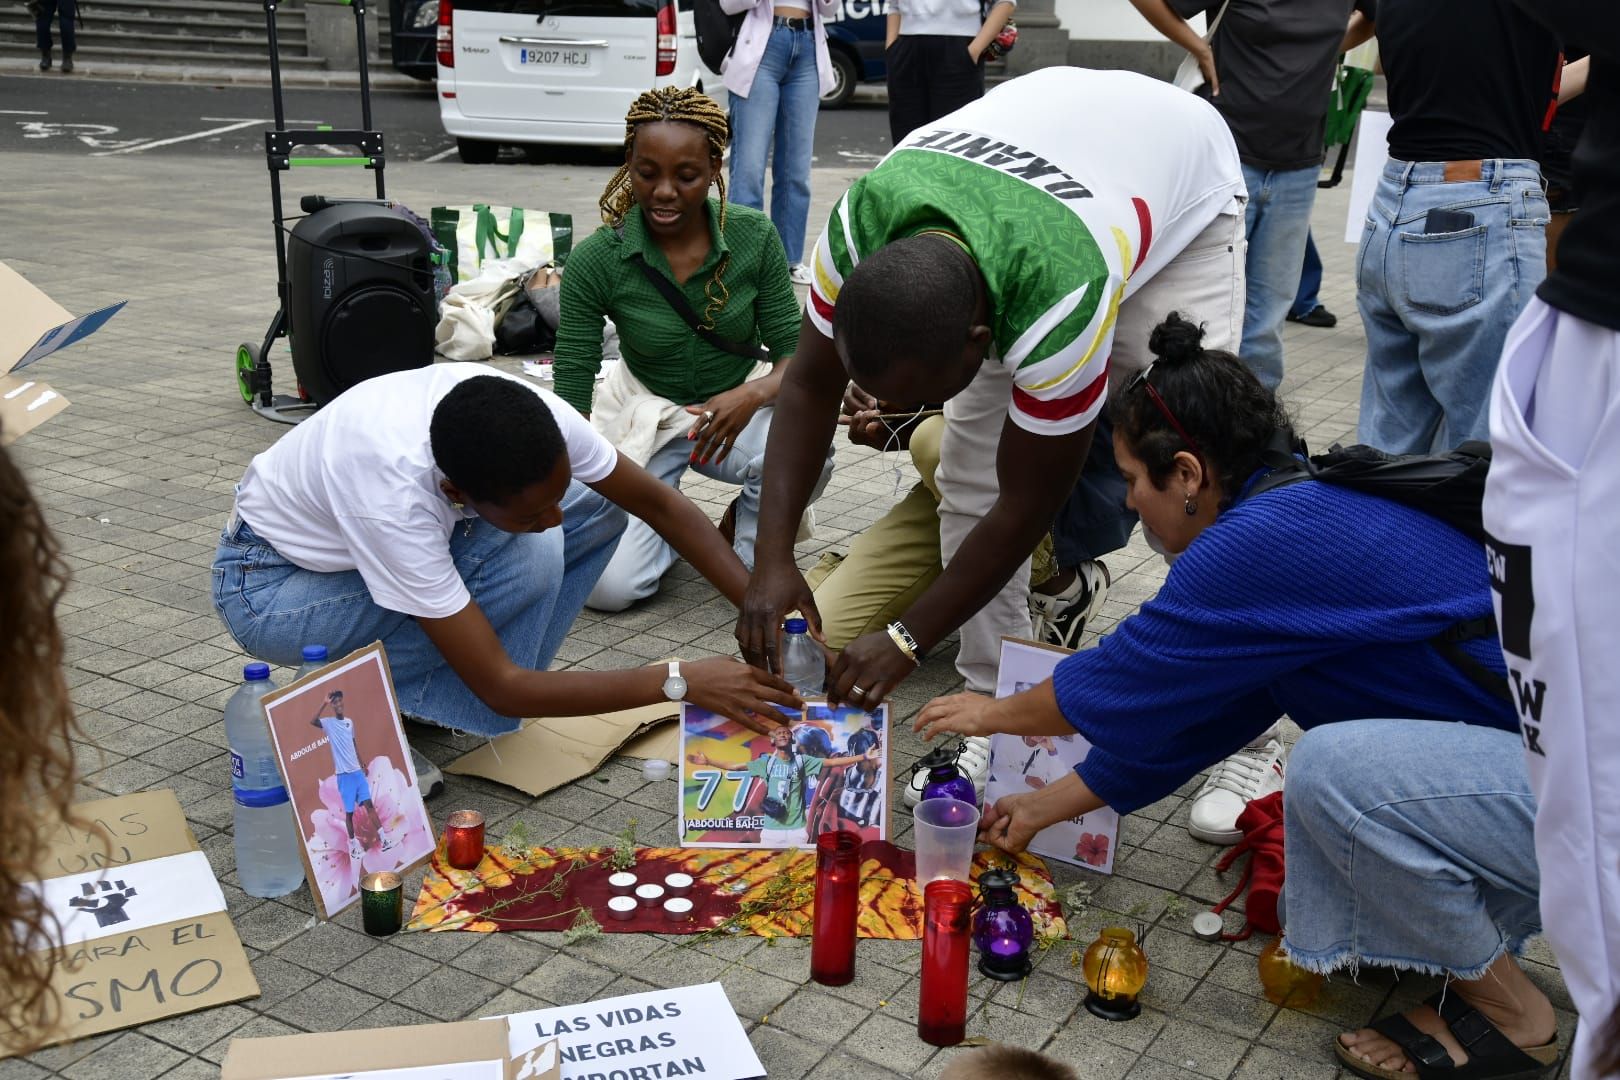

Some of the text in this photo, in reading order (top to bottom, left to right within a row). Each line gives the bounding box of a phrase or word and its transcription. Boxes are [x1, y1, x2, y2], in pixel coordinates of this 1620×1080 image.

[528, 50, 588, 65] 9207 HCJ
[688, 817, 734, 830] ABDOULIE
[171, 923, 216, 946] EL
[65, 958, 223, 1020] SMO
[535, 1001, 682, 1038] LAS VIDAS
[560, 1031, 676, 1065] NEGRAS
